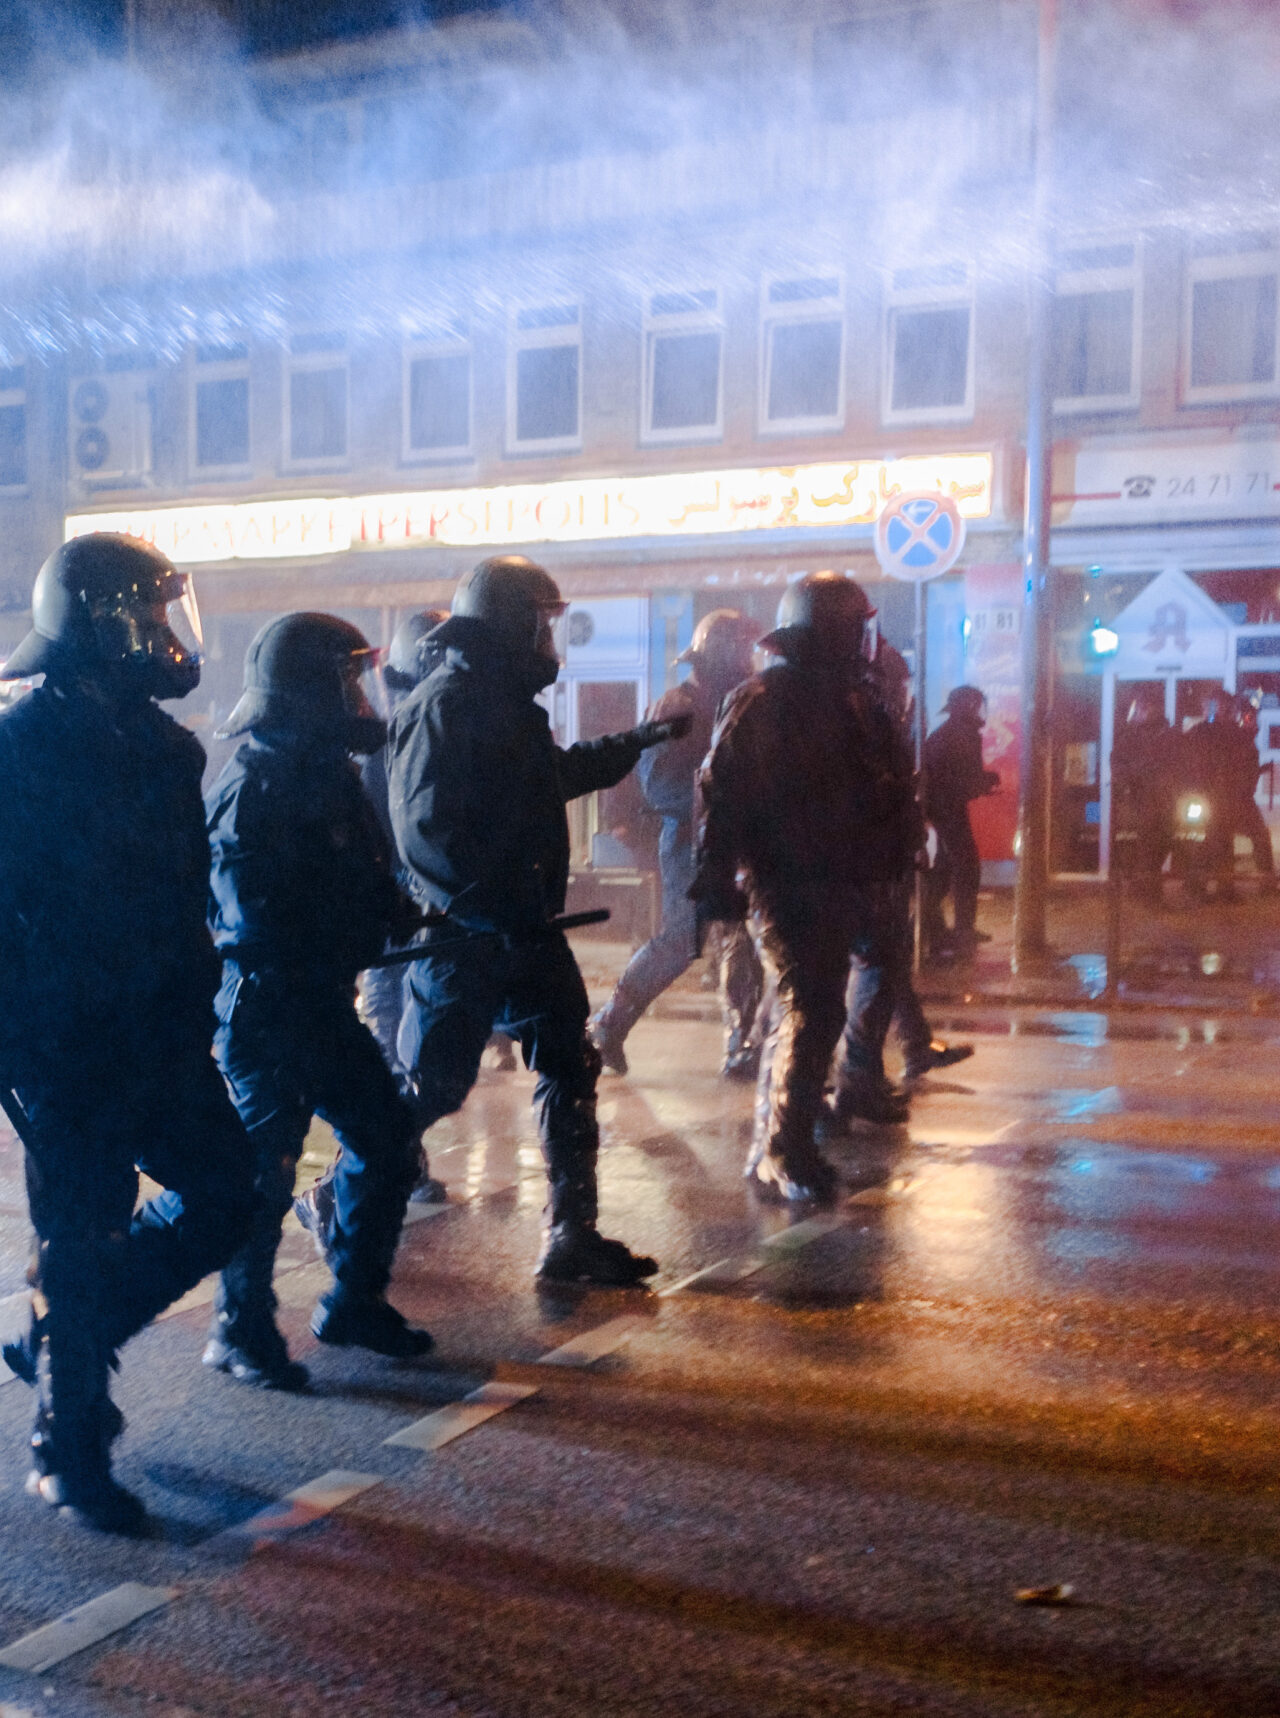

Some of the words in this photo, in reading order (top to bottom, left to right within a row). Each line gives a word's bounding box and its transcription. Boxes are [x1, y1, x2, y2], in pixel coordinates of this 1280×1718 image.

[1167, 476, 1195, 498] 24
[1208, 474, 1231, 497] 71
[73, 506, 372, 550] ERMARKET
[376, 492, 640, 542] PERSEPOLIS
